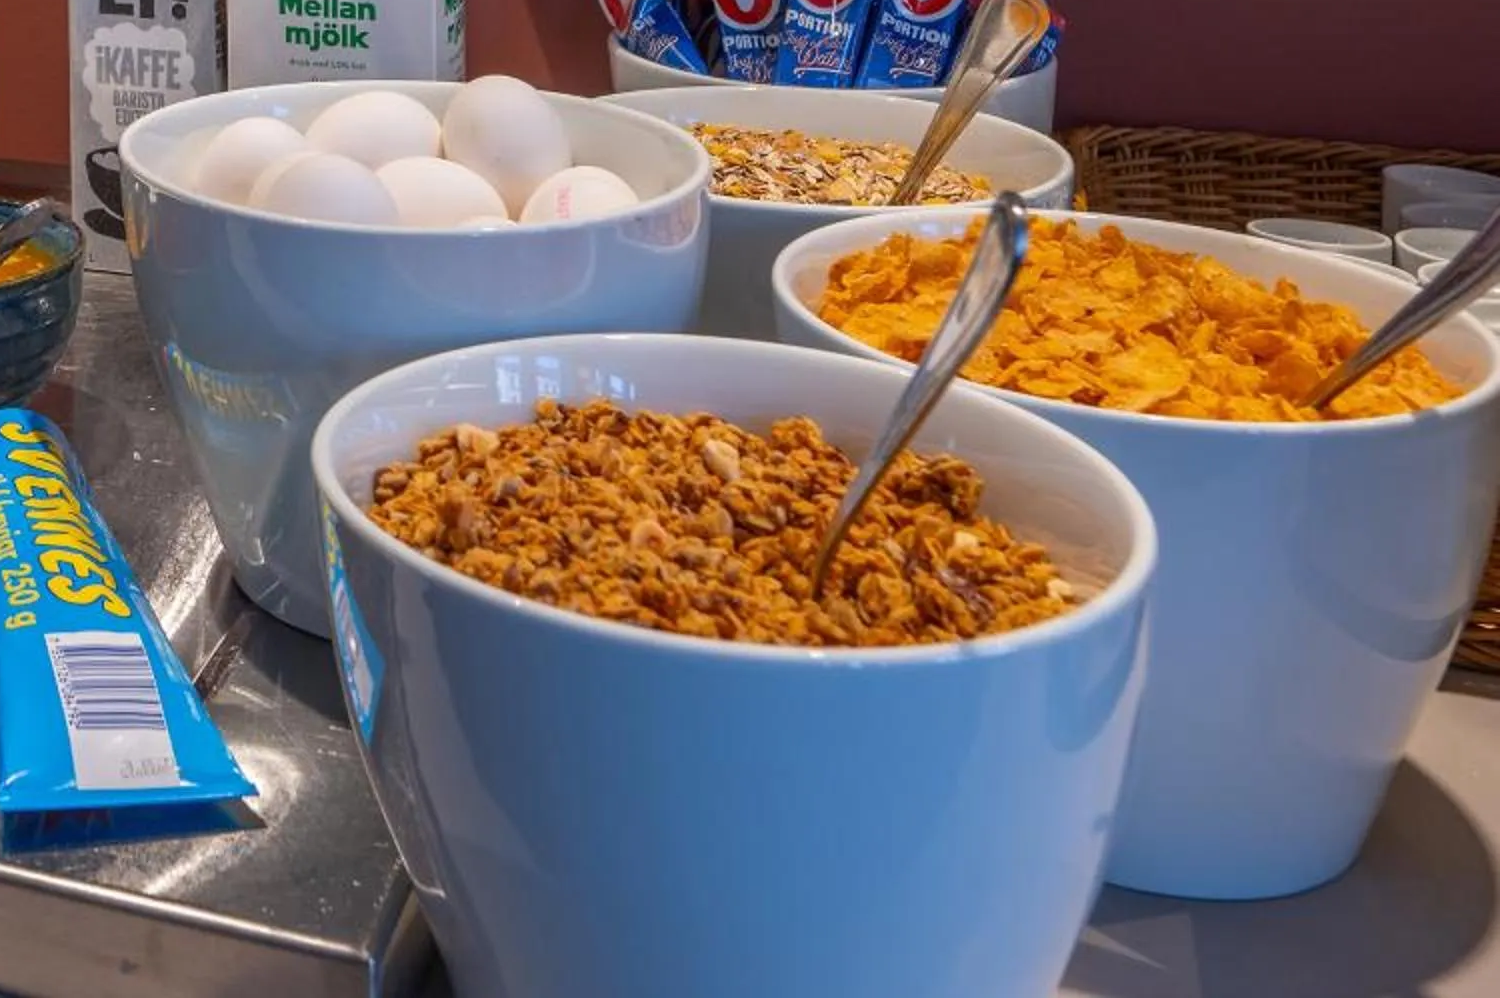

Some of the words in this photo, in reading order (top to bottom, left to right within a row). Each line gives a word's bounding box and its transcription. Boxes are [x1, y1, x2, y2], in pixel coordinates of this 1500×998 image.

[285, 22, 370, 51] mjölk
[784, 9, 855, 37] PORTION
[881, 11, 950, 48] PORTION
[722, 33, 780, 51] PORTIO
[95, 46, 181, 90] iKAFFE
[113, 90, 165, 110] BARISTA
[0, 423, 132, 617] SVENNES
[1, 563, 41, 606] 250
[5, 611, 37, 630] g
